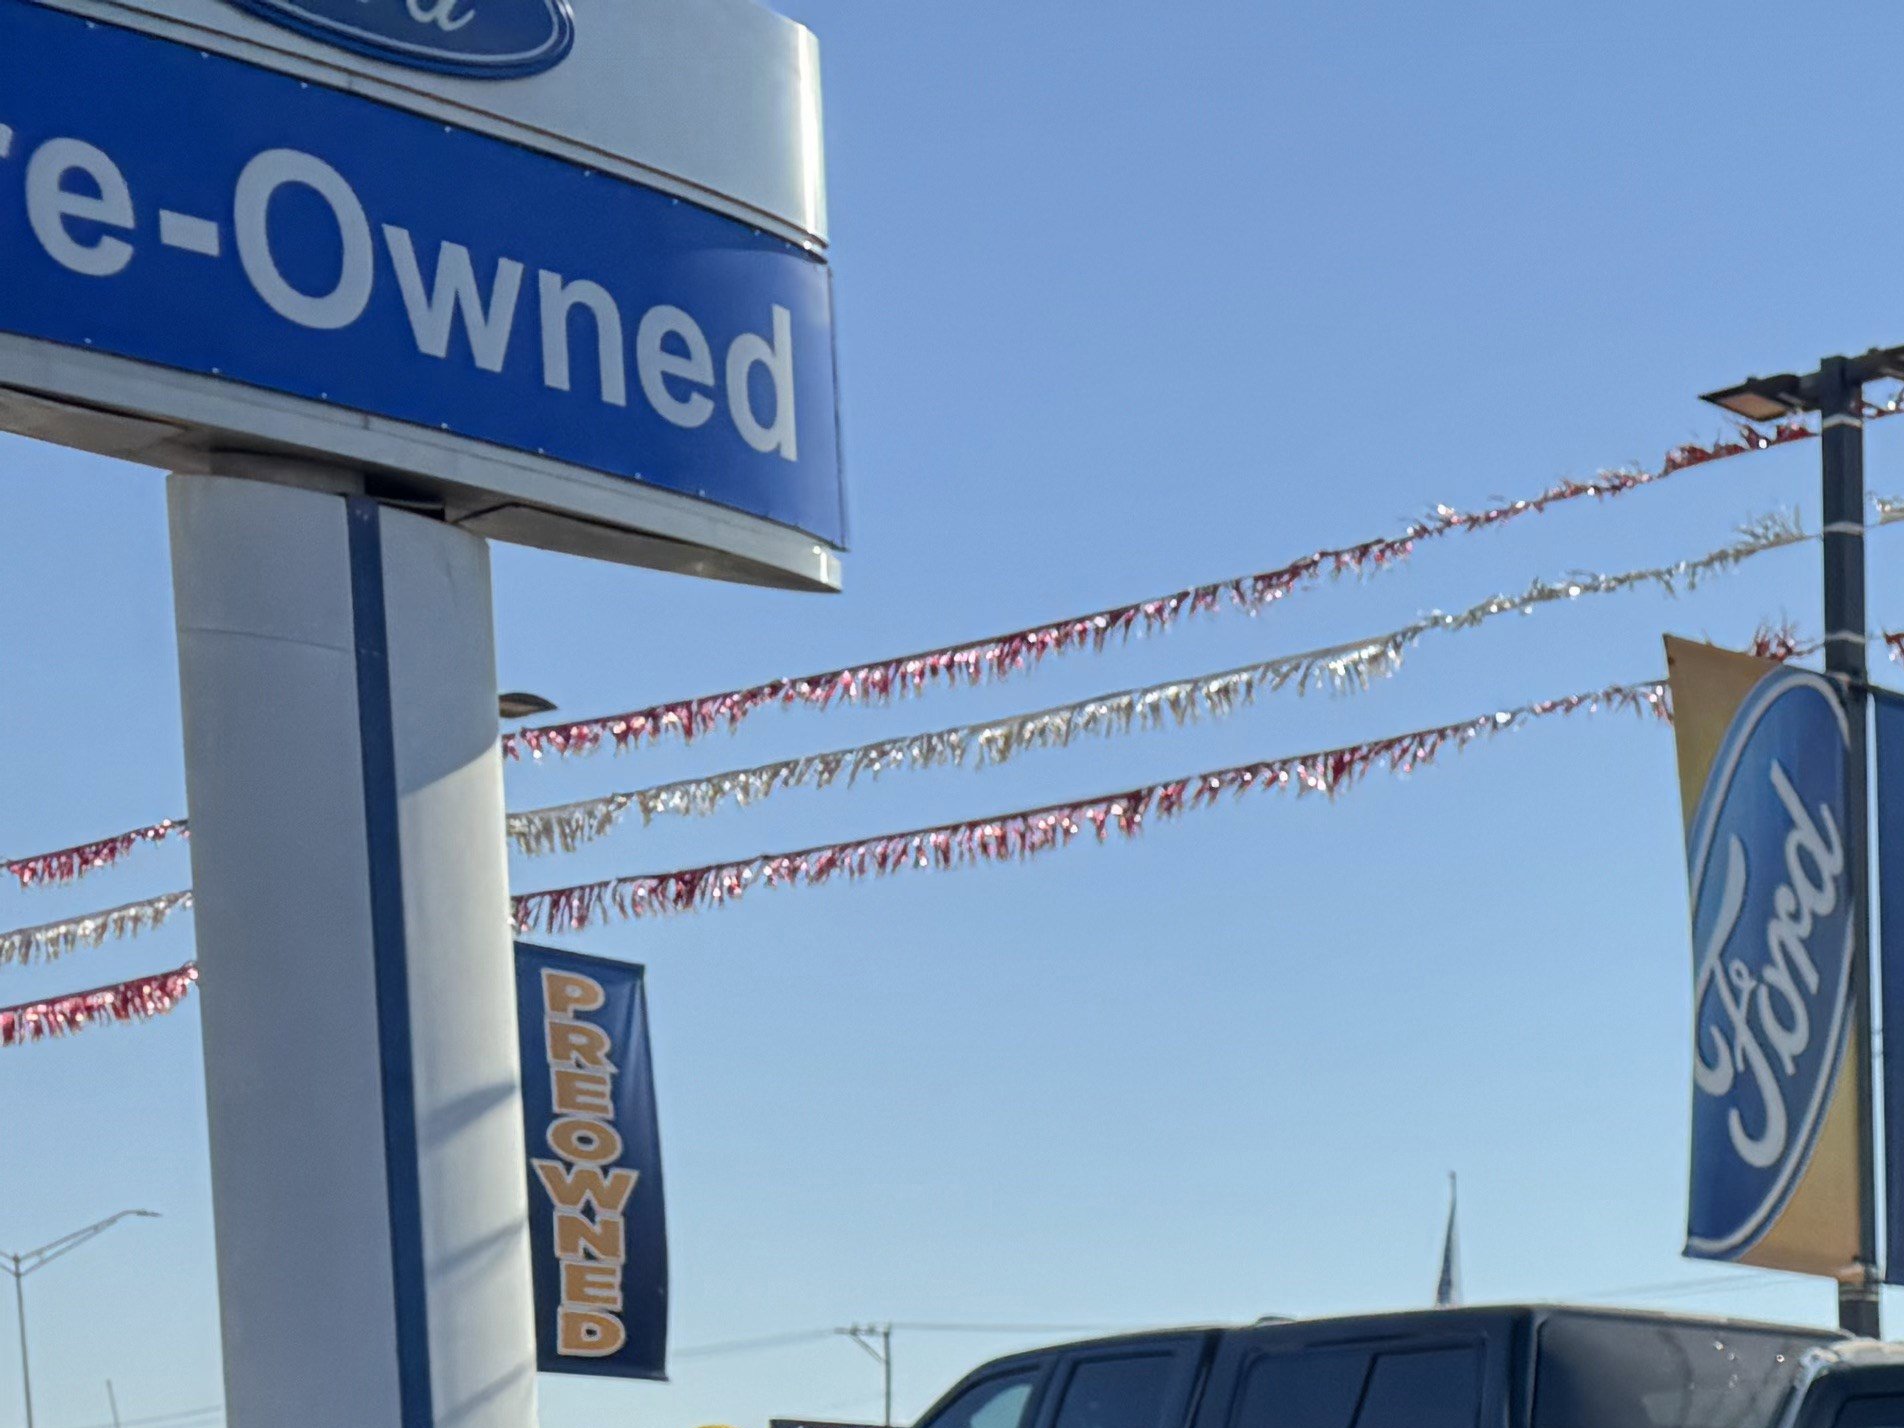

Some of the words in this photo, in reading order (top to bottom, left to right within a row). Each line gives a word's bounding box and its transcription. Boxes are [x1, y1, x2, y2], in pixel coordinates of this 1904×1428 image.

[0, 122, 798, 462] e-Owned
[1693, 758, 1846, 1169] Ford
[530, 967, 639, 1357] PREOWNED
